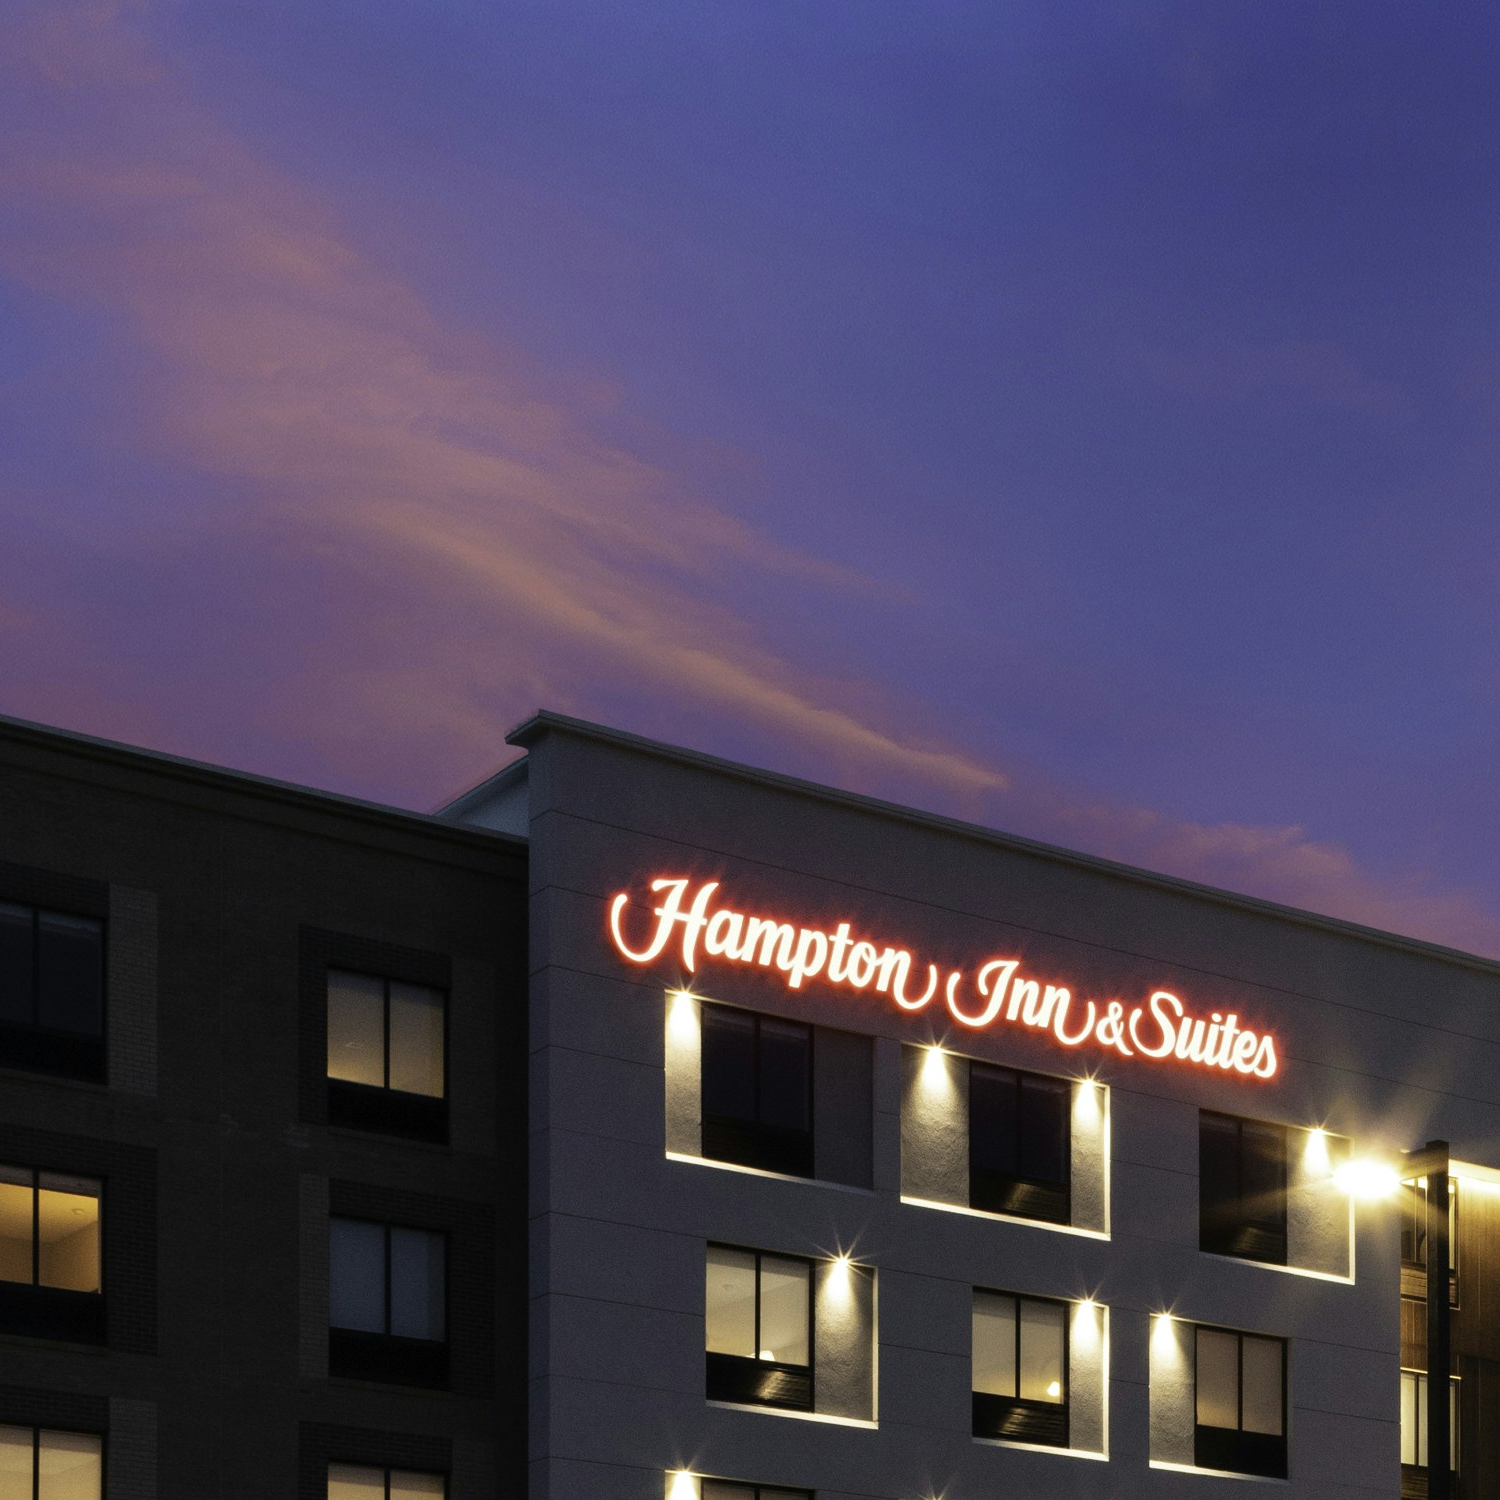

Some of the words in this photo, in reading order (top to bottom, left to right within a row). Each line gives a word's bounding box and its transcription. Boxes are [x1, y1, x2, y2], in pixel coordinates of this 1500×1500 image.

[610, 878, 937, 1011] Hampton
[947, 960, 1097, 1046] Inn
[1096, 1002, 1134, 1056] &
[1129, 991, 1278, 1079] Suites
